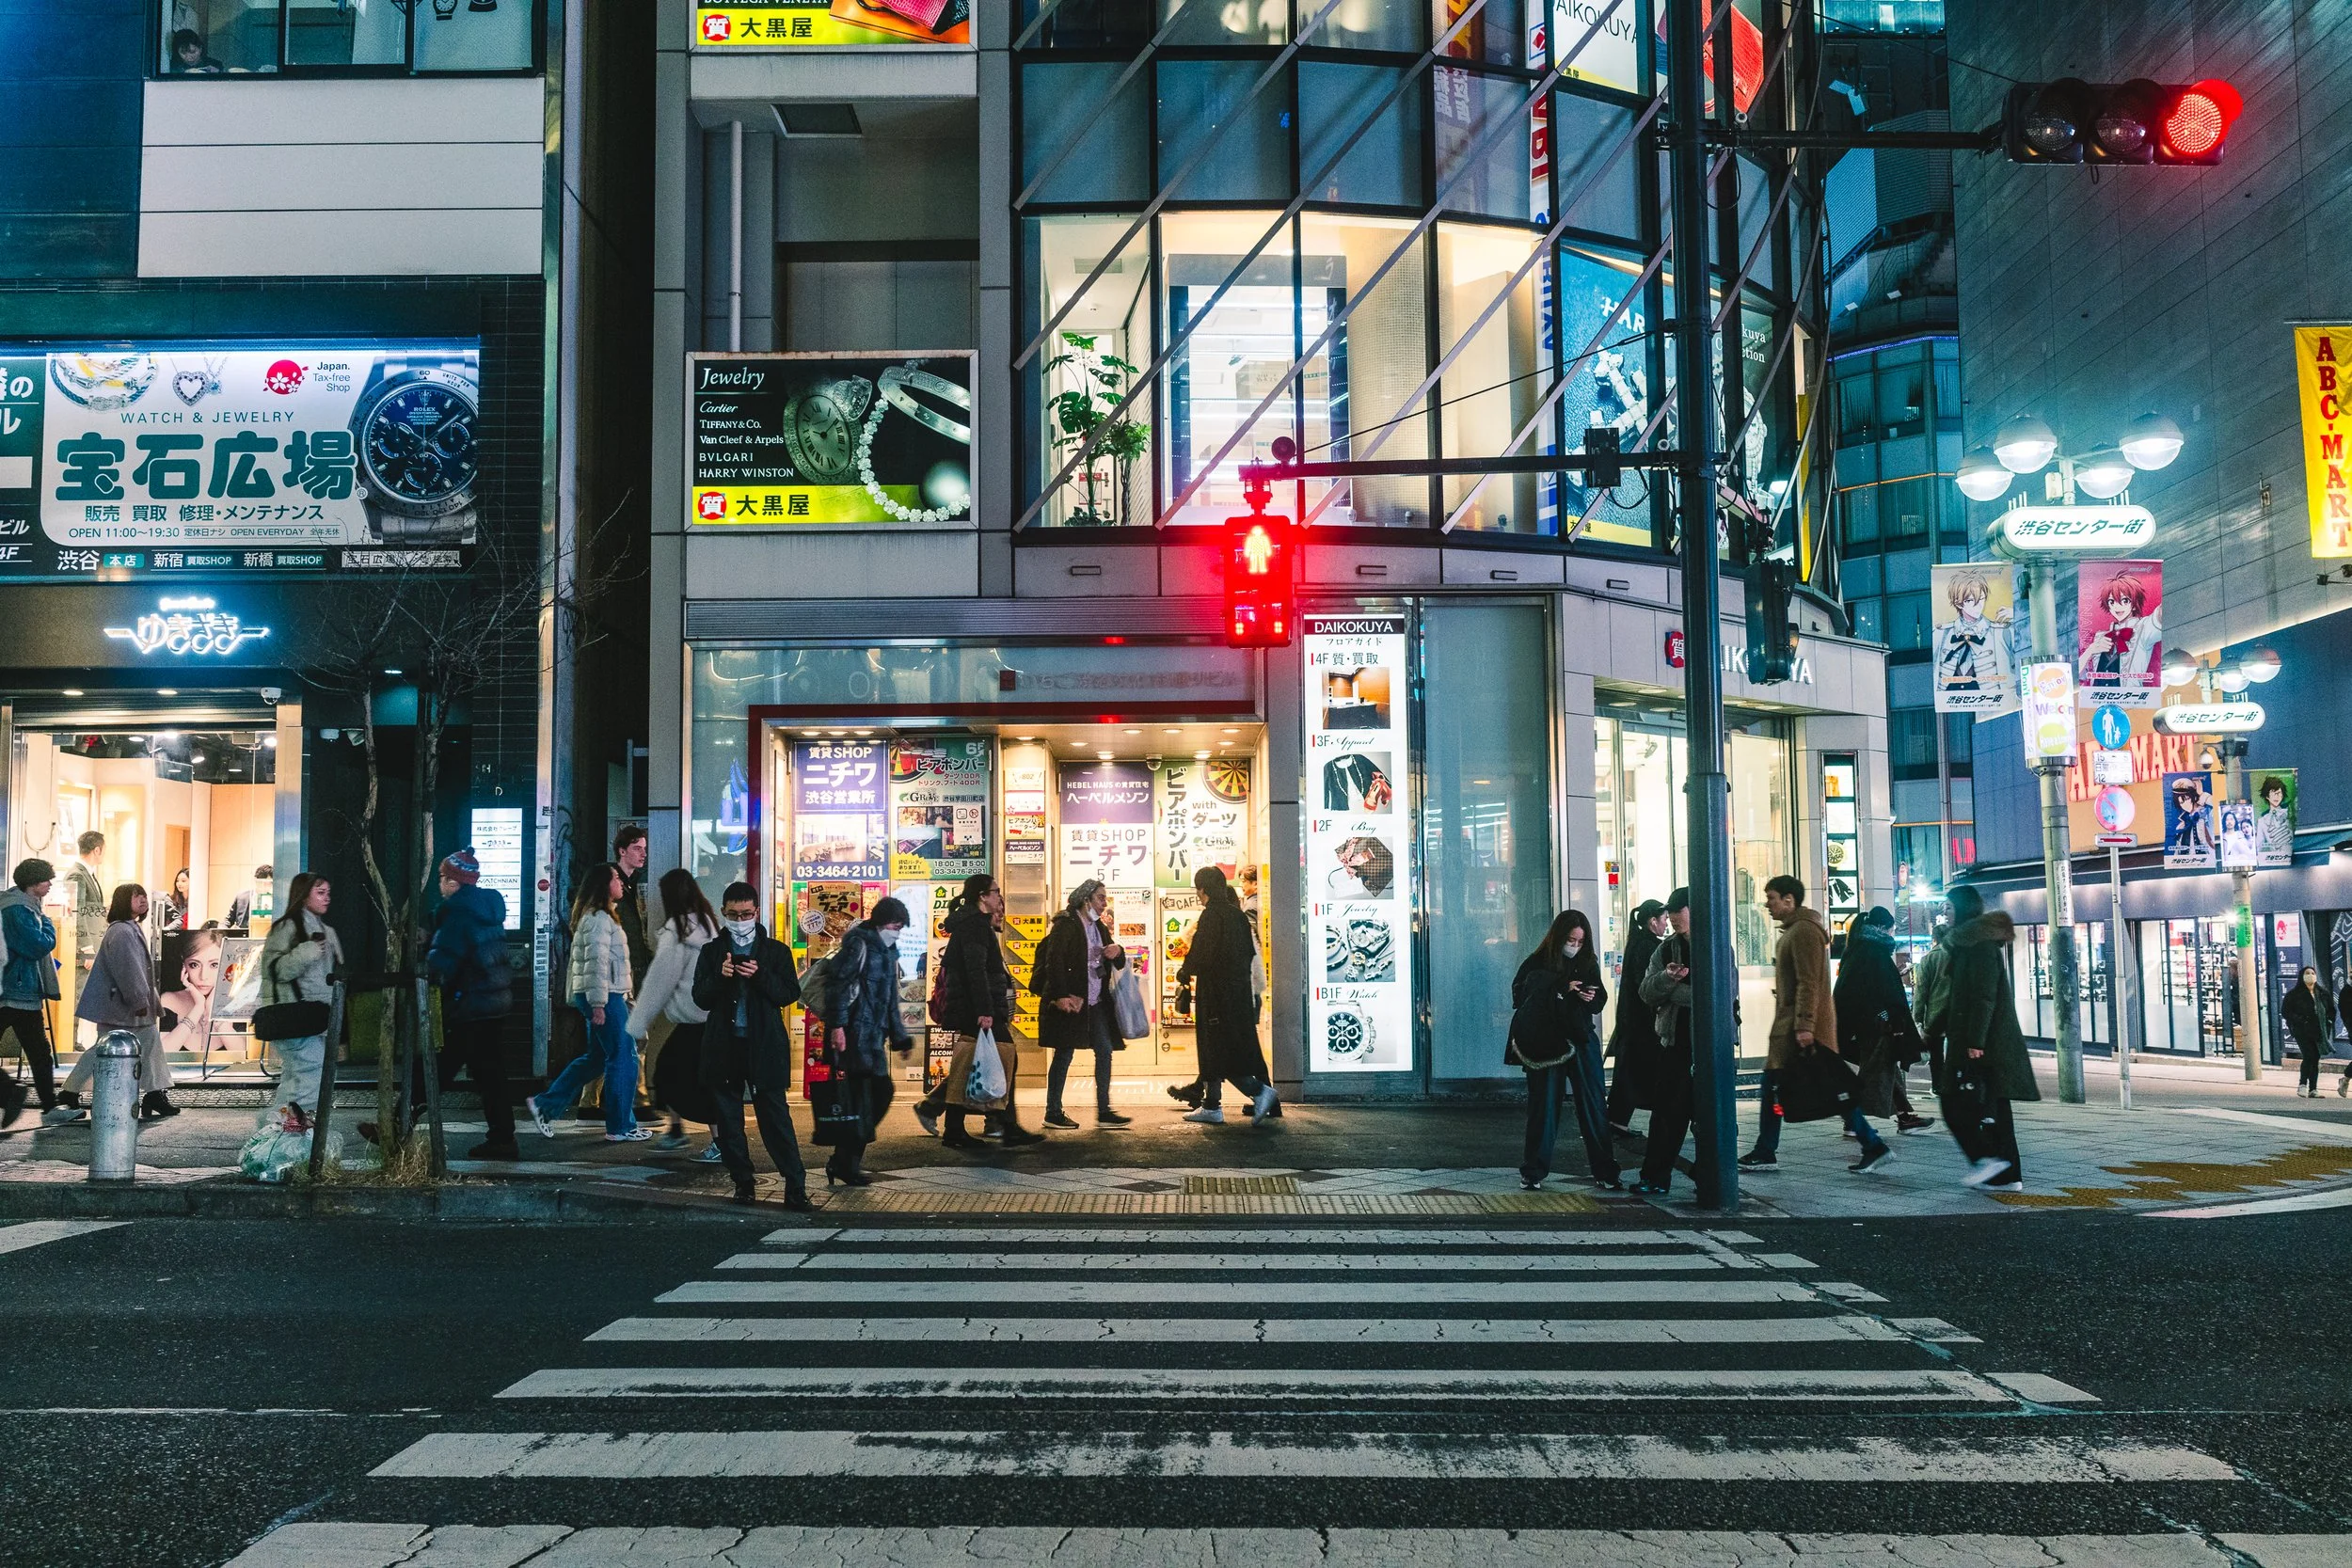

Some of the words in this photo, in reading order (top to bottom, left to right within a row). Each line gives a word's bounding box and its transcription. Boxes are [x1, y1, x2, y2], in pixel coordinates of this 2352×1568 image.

[706, 17, 729, 38] 質
[740, 17, 813, 39] 大黒屋
[317, 361, 351, 372] Japan.
[313, 373, 351, 383] Tax-free
[700, 367, 765, 389] Jewelry
[326, 383, 351, 394] Shop
[699, 401, 739, 413] Cartier
[120, 412, 184, 424] WATCH
[193, 411, 204, 423] &
[212, 410, 294, 423] JEWELRY
[699, 435, 718, 445] Van
[719, 435, 743, 445] Cleef
[745, 436, 753, 445] &
[755, 435, 784, 446] Arpels
[2315, 336, 2351, 547] ABC-MART
[699, 452, 754, 462] BVLGARI
[55, 429, 357, 501] 宝石広場
[699, 468, 737, 479] HARRY
[741, 467, 795, 478] WINSTON
[701, 496, 724, 517] 質
[736, 494, 810, 516] 大黒屋
[85, 505, 120, 522] 販売
[133, 505, 167, 522] 買取
[179, 504, 325, 521] 修理・メンテナンス
[69, 528, 101, 538] OPEN
[183, 528, 226, 537] 定休日ナシ
[230, 528, 255, 536] OPEN
[257, 527, 305, 536] EVERYDAY
[2013, 518, 2147, 536] 渋谷センター街
[57, 549, 101, 571] 渋谷
[108, 555, 137, 567] 本店
[153, 552, 184, 568] 新宿
[187, 556, 232, 565] 買取SHOP
[244, 551, 274, 567] 新橋
[277, 555, 323, 565] 買取SHOP
[1314, 621, 1393, 633] DAIKOKUYA
[1326, 637, 1383, 646] フロアガイド
[1315, 653, 1329, 665] 4F
[1332, 652, 1379, 666] 質・買取
[1946, 693, 2004, 705] 渋谷センター街
[2090, 691, 2150, 701] 渋谷センター街
[2172, 710, 2259, 723] 渋谷センター街
[1317, 735, 1330, 747] 3F
[808, 747, 872, 759] 賃貸SHOP
[803, 761, 877, 787] ニチワ
[1115, 781, 1149, 789] の賃貸住宅
[804, 790, 875, 805] 渋谷営業所
[1067, 792, 1149, 804] ヘーベルメゾン
[1192, 800, 1217, 810] with
[1166, 766, 1188, 882] ビアポンバー
[1192, 812, 1237, 826] ダーツ
[1319, 819, 1332, 832] 2F
[1071, 829, 1147, 842] 賃貸SHOP
[1070, 845, 1147, 866] ニチワ
[796, 864, 883, 879] 03-3464-2101
[1321, 903, 1334, 915] 1F
[1321, 987, 1343, 1000] B1F
